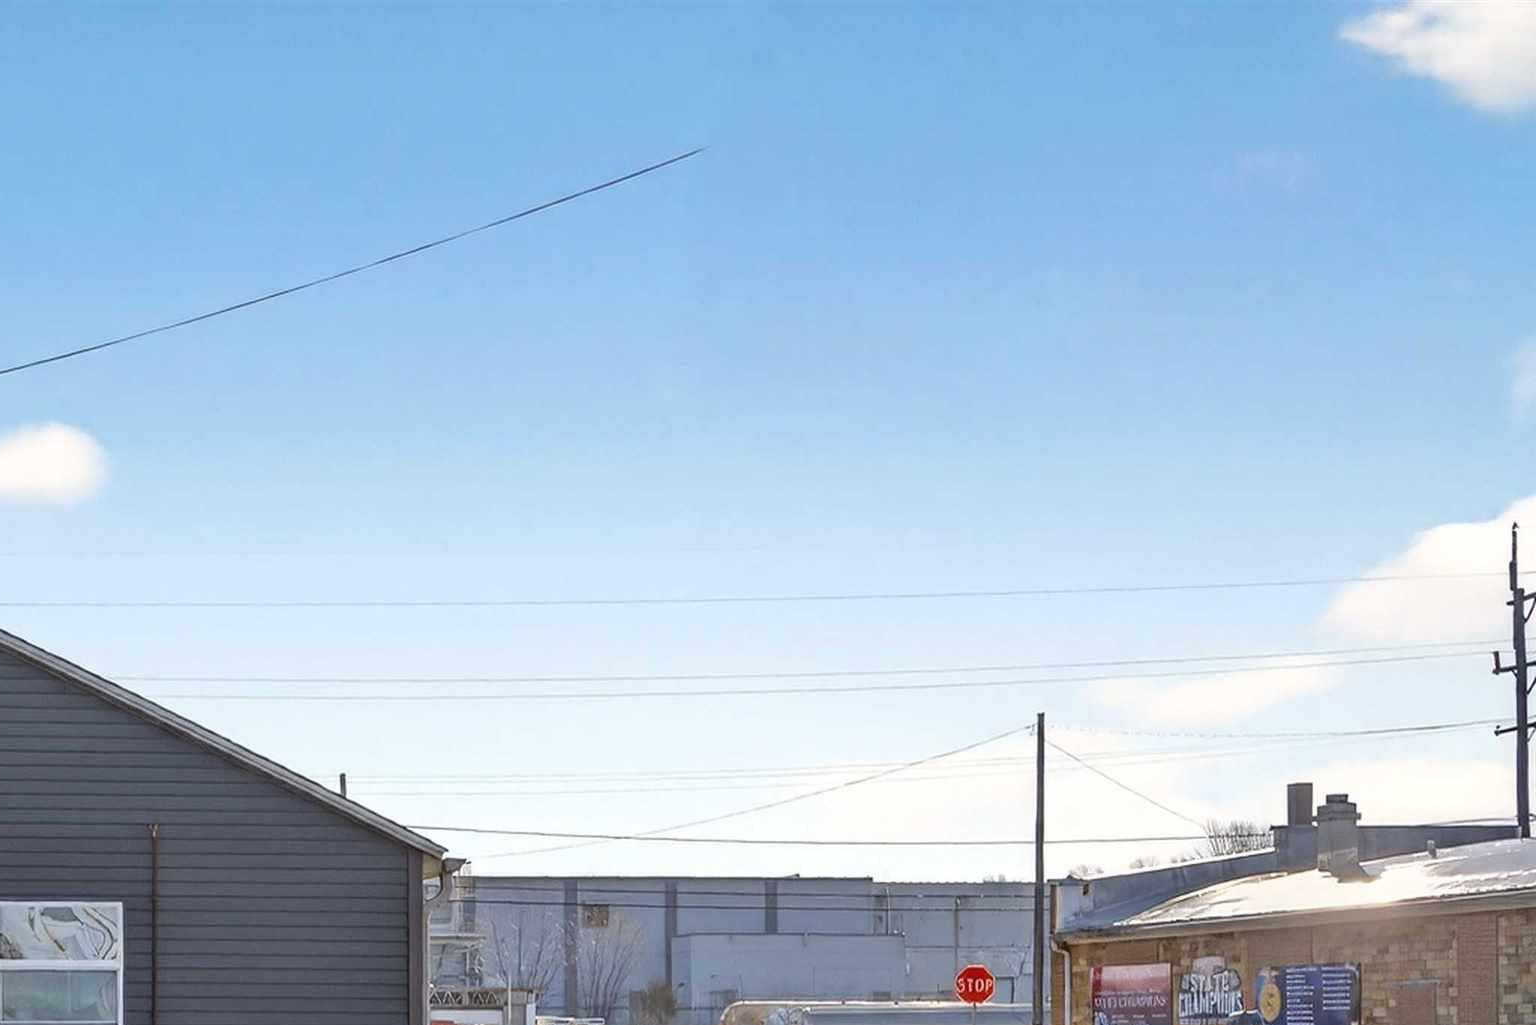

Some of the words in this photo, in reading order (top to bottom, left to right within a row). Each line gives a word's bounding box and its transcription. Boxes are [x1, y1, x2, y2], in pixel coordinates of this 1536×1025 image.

[958, 978, 993, 993] STOP
[1190, 972, 1230, 992] STATE
[1178, 991, 1244, 1017] CHAMPIONS
